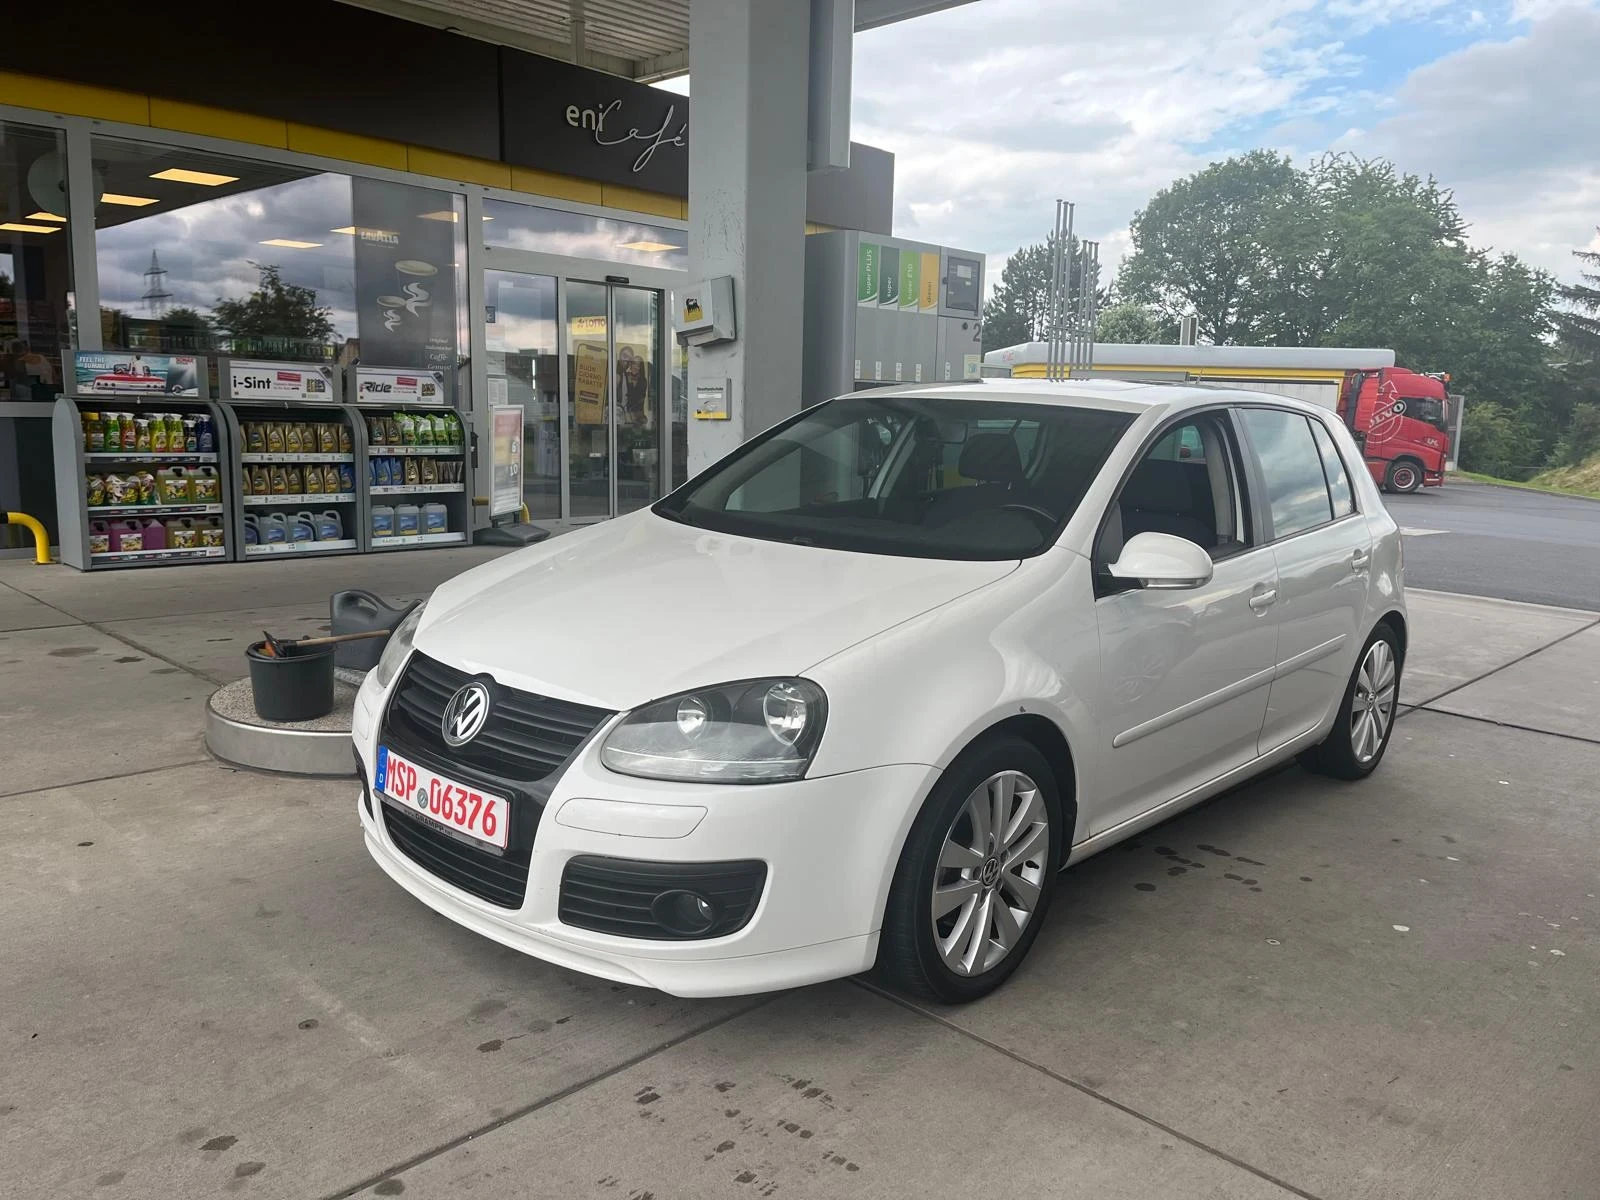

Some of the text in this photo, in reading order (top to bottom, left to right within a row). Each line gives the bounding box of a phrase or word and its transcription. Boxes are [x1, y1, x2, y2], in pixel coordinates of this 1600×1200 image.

[566, 99, 687, 172] eni Café
[584, 318, 606, 328] LOTTO
[972, 323, 981, 342] 2
[232, 375, 272, 390] i-Sint
[379, 756, 497, 837] D MSP 06376
